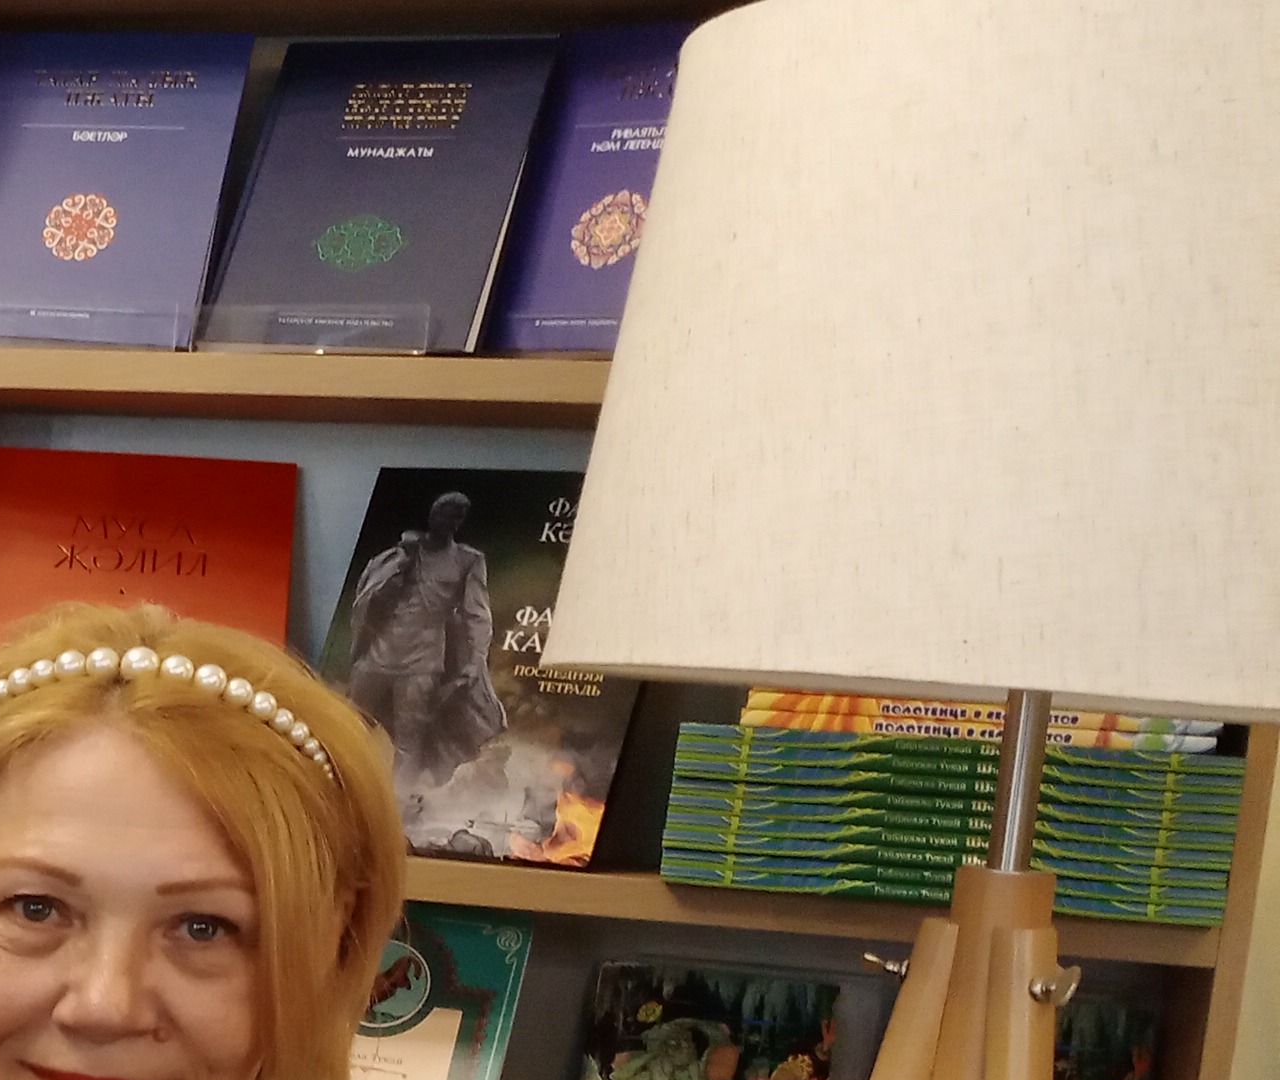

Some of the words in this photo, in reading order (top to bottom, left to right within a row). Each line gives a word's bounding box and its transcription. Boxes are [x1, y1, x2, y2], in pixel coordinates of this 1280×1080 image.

[347, 148, 433, 158] МУНАДЖАТЫ
[71, 515, 196, 545] МУСА
[538, 680, 601, 697] ТЕТРАДЬ
[881, 703, 967, 720] ПОЛОТЕНЦЕ
[875, 722, 960, 737] ПОЛОТЕНЦЕ
